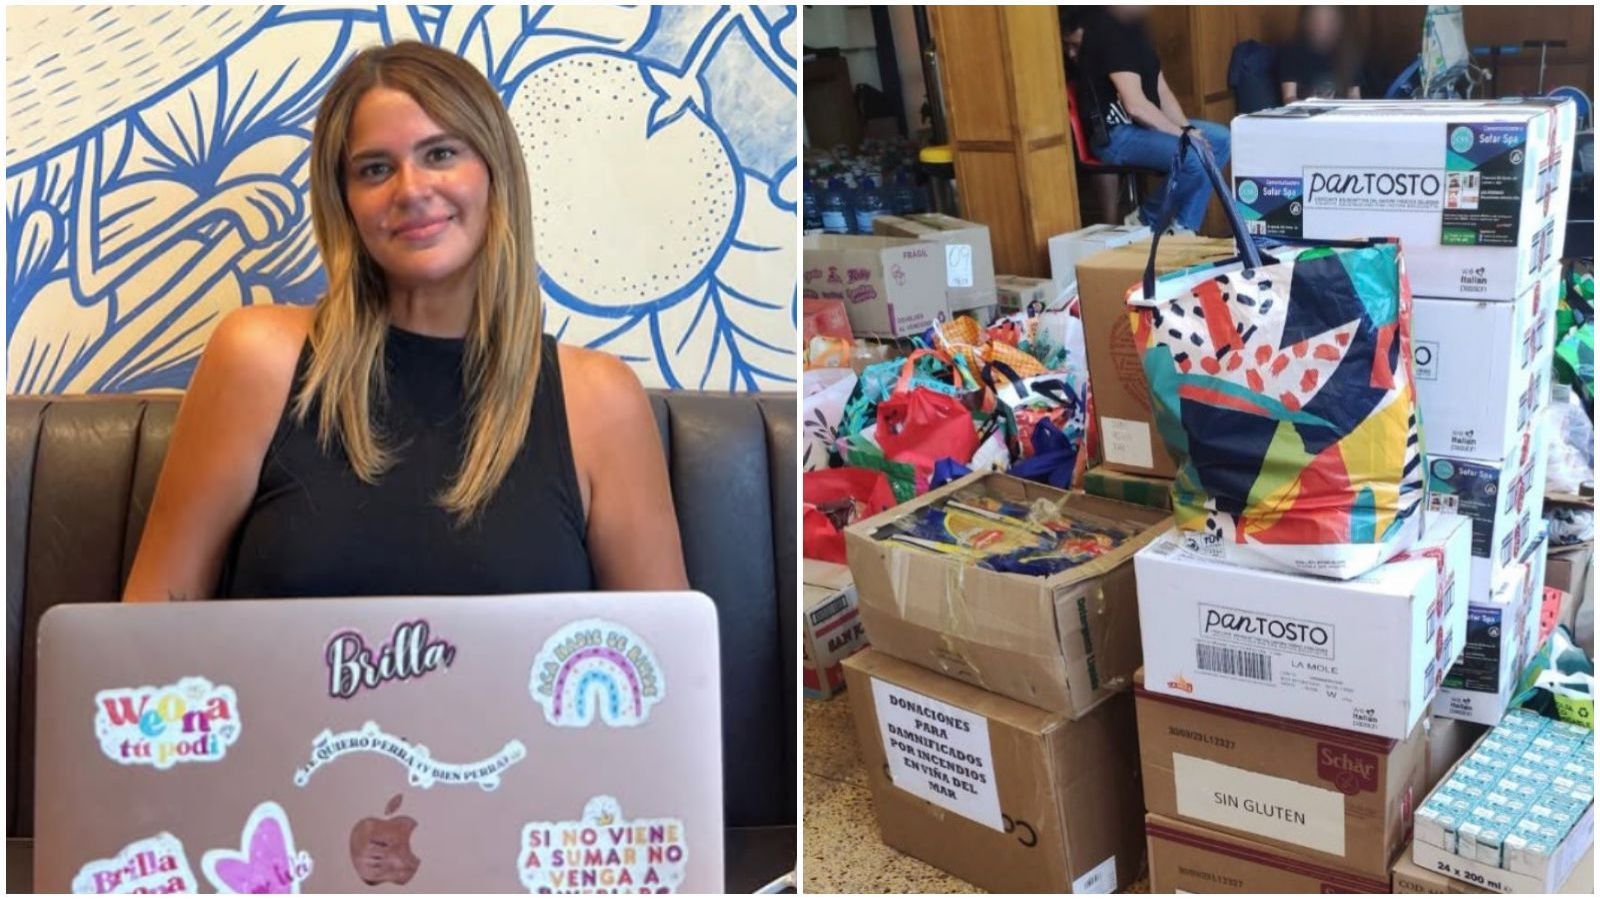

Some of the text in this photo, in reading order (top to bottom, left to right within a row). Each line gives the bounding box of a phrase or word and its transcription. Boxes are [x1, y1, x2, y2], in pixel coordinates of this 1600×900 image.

[326, 620, 456, 699] Brilla
[1291, 659, 1339, 674] LA MOLE
[889, 695, 970, 732] DONACIONES
[915, 719, 948, 739] PARA
[888, 723, 983, 767] DAMNIFICADOS
[890, 738, 986, 784] POR INCENDIOS
[903, 757, 978, 794] EN VIÑA DEL
[1321, 748, 1376, 780] Schär
[928, 781, 957, 800] MAR
[1214, 791, 1306, 825] SIN GLUTEN
[530, 825, 678, 847] SI NO VIENE
[92, 850, 178, 893] Brilla
[525, 845, 682, 868] A SUMAR NO
[550, 867, 660, 886] VENGA A
[1437, 861, 1451, 872] 24
[1464, 870, 1485, 883] 200
[1488, 878, 1501, 889] ml
